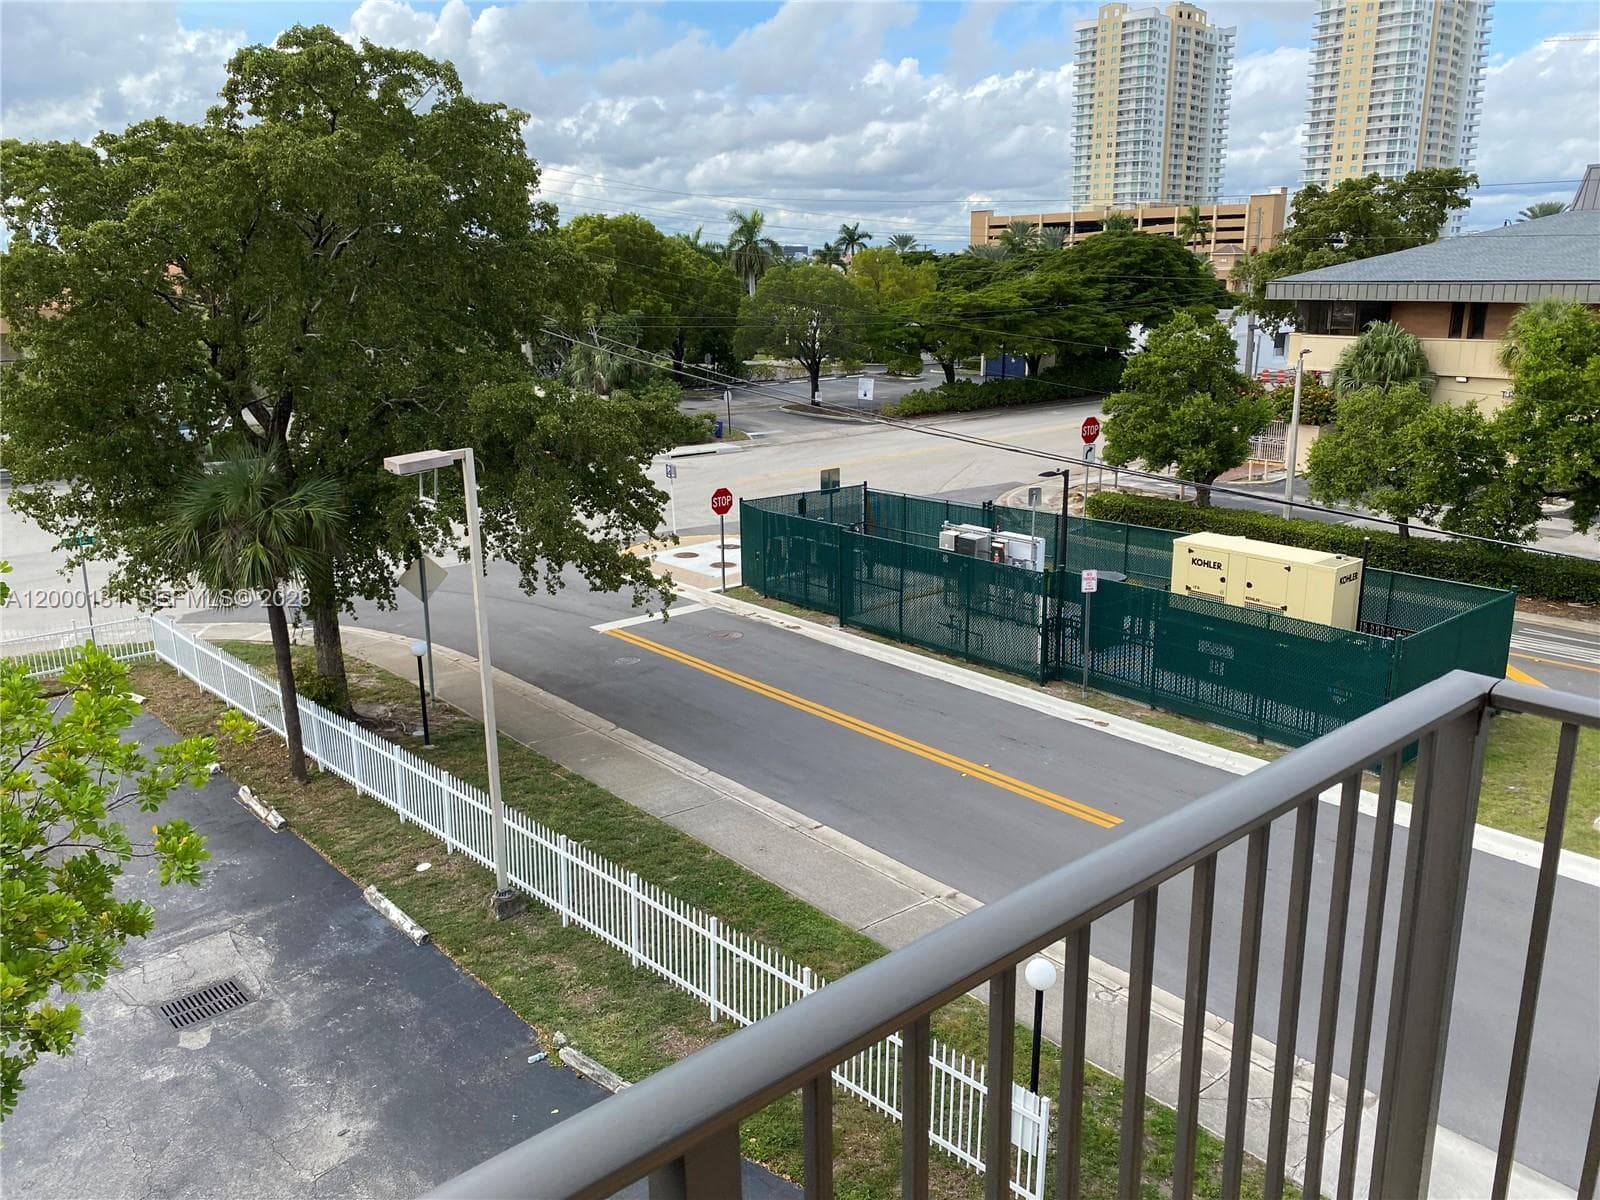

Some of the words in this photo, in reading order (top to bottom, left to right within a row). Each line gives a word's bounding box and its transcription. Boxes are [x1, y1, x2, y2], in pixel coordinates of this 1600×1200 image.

[1082, 424, 1099, 436] STOP
[712, 495, 732, 508] STOP
[1191, 557, 1222, 571] KOHLER
[1339, 572, 1358, 585] KOHLER
